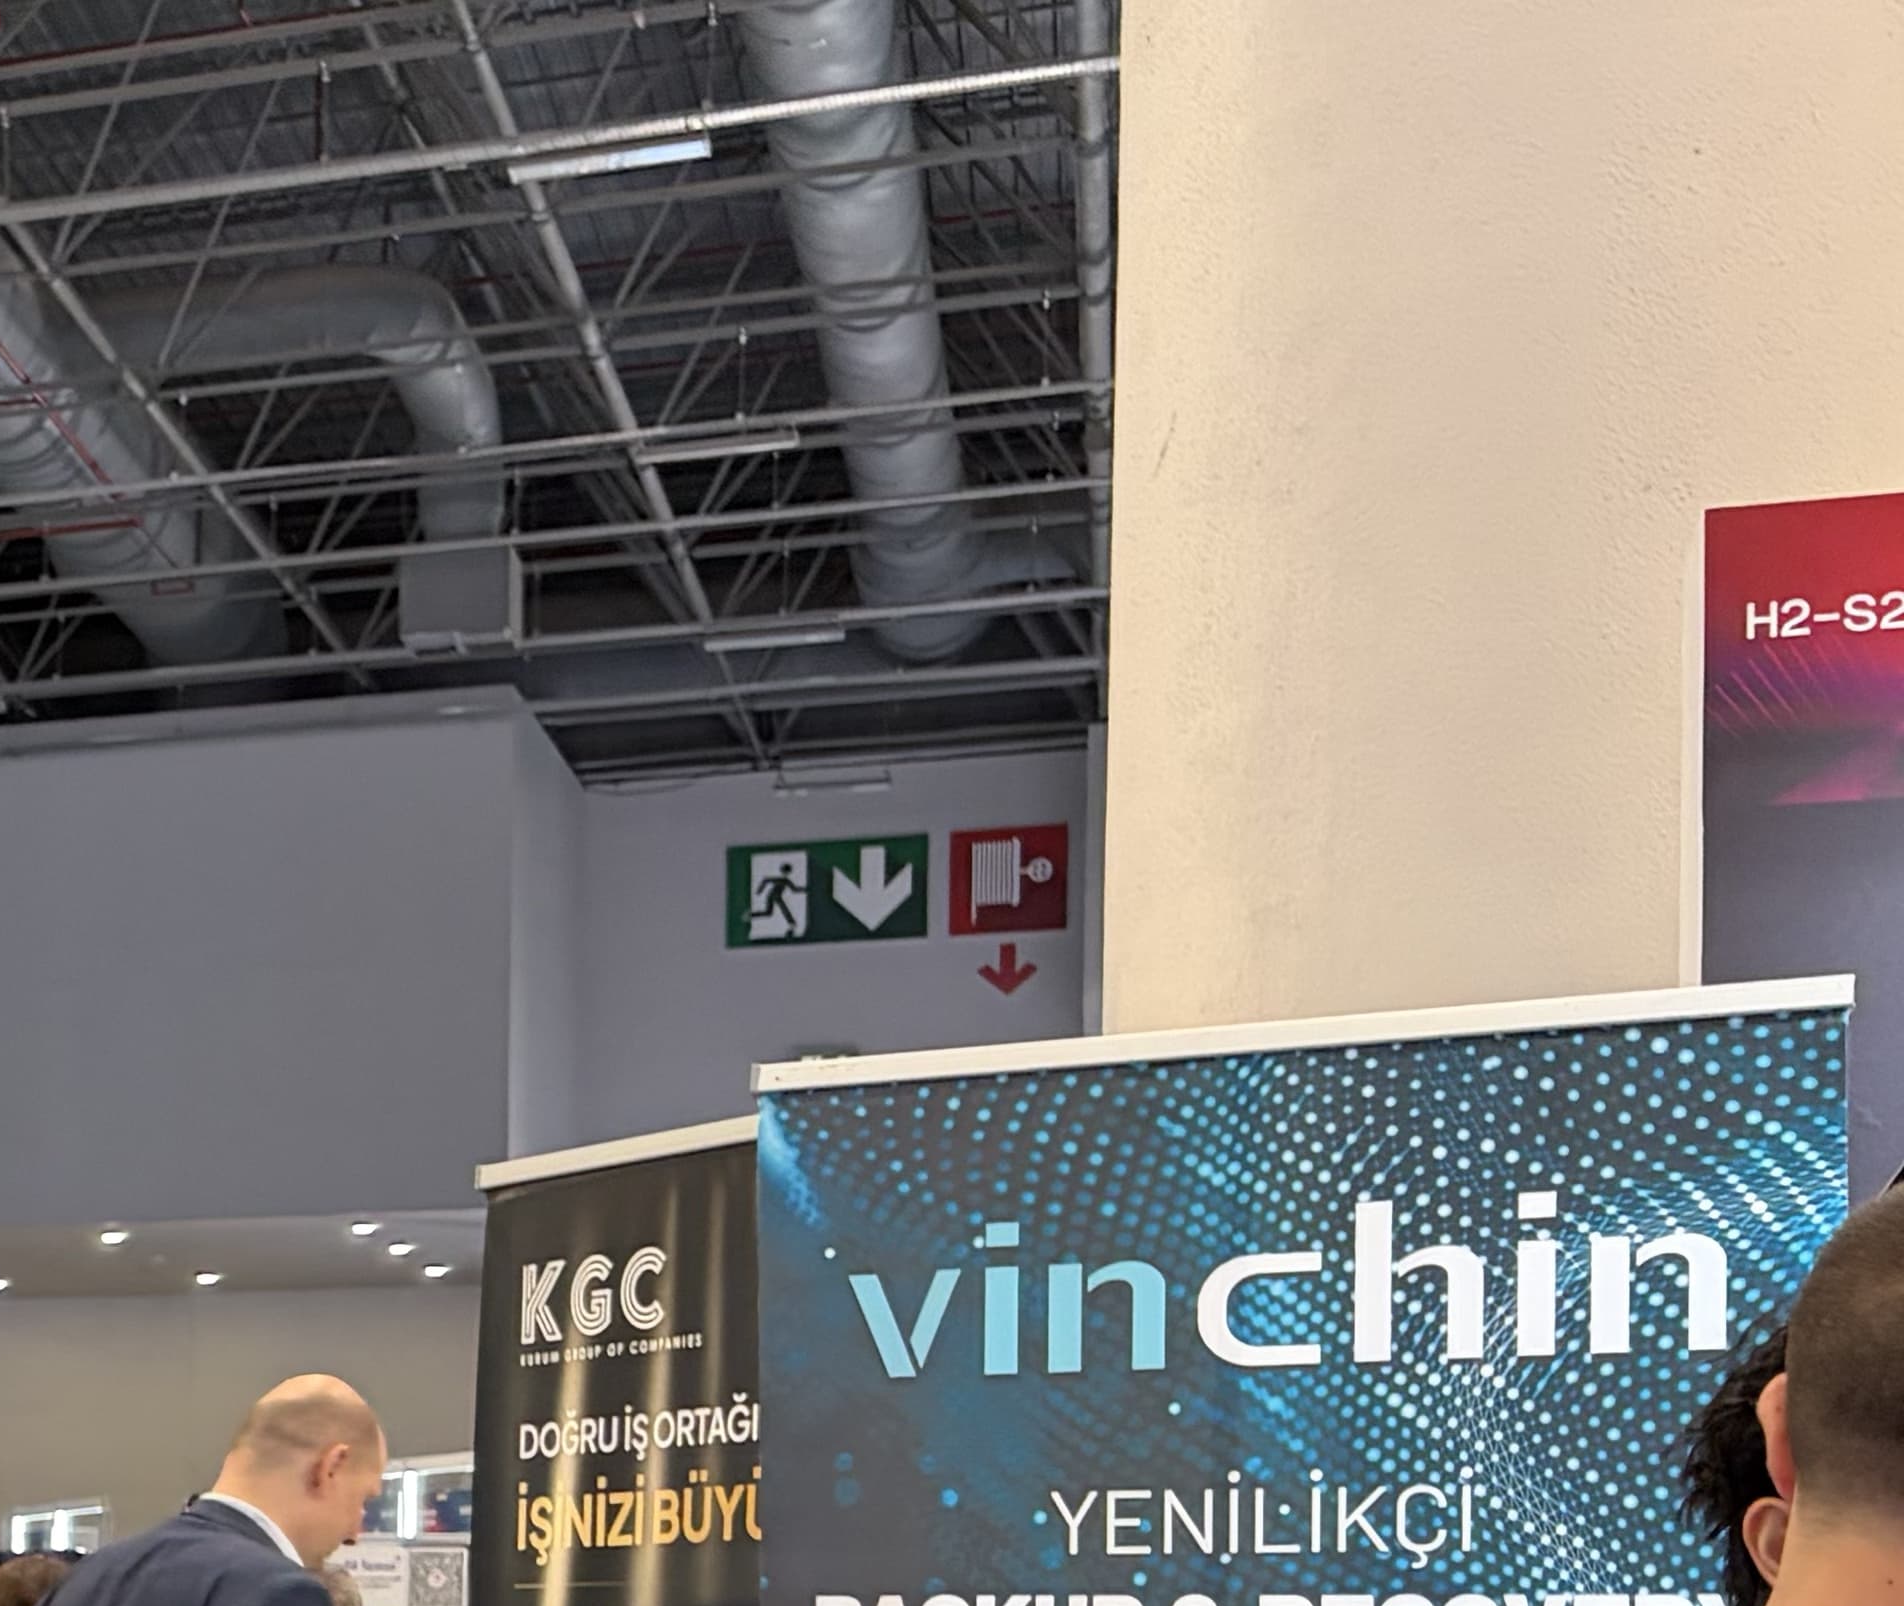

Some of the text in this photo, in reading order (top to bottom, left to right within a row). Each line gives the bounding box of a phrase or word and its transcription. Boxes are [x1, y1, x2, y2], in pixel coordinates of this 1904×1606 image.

[521, 1246, 667, 1345] KGC
[849, 1190, 1729, 1377] vinchin
[564, 1345, 601, 1362] GROUP
[607, 1342, 624, 1357] OF
[629, 1333, 702, 1354] COMPANIES
[520, 1393, 759, 1461] DOĞRU İŞ ORTAĞI
[1051, 1465, 1475, 1568] YENİLİKÇİ
